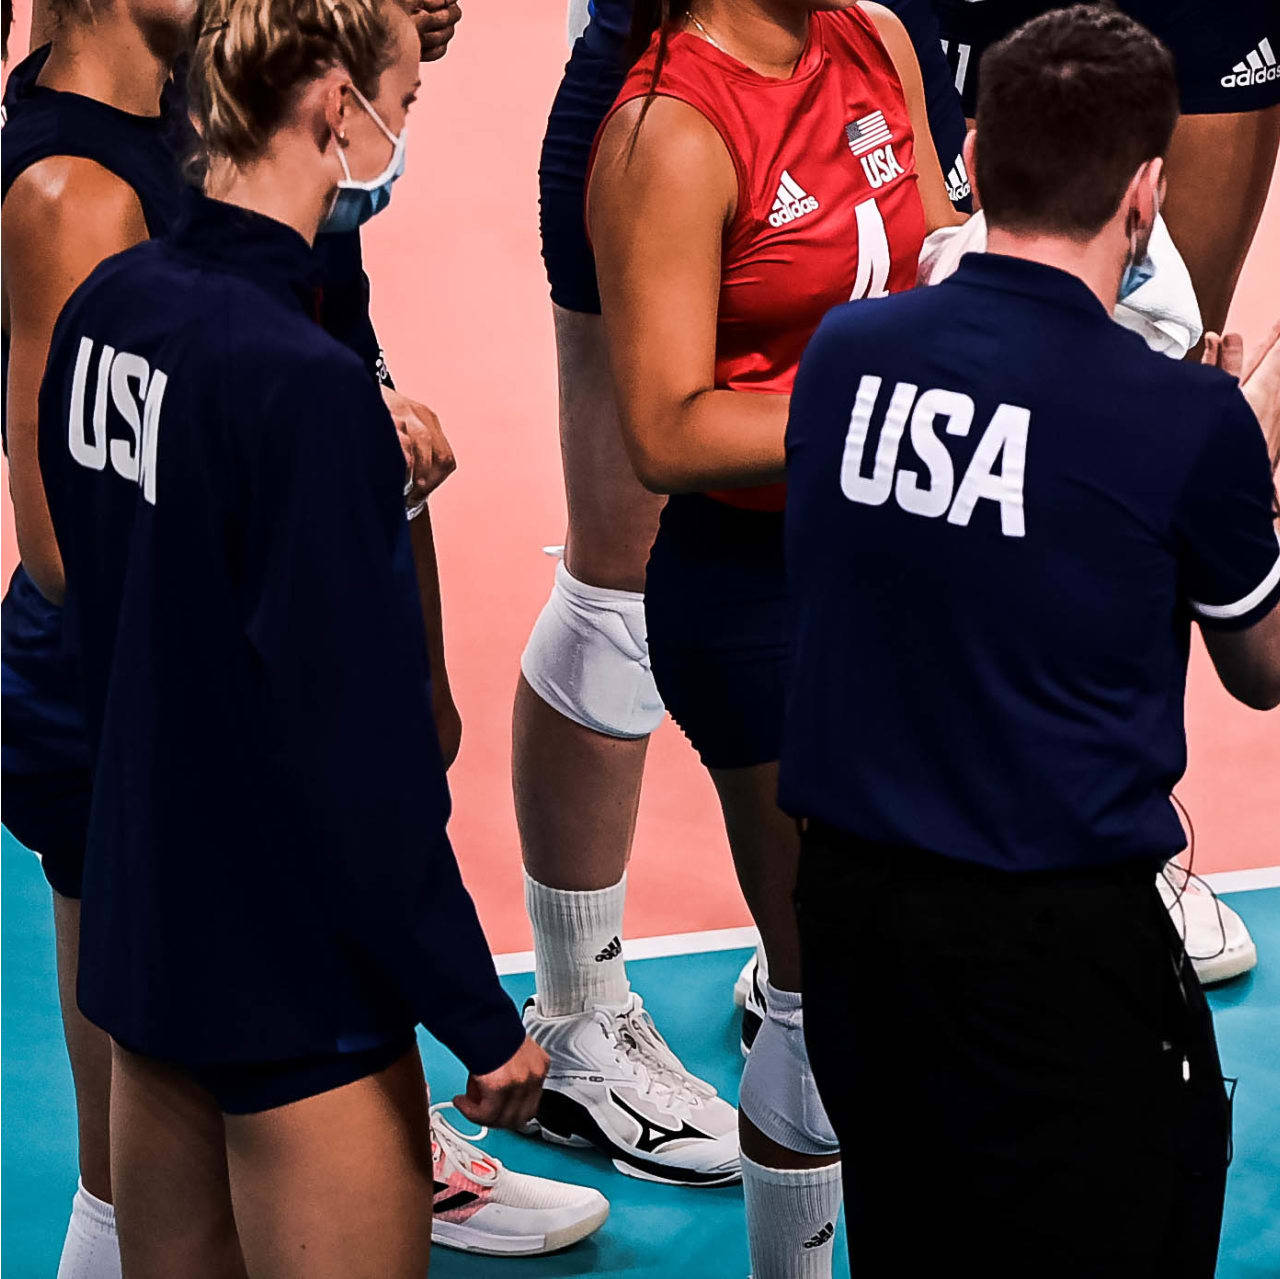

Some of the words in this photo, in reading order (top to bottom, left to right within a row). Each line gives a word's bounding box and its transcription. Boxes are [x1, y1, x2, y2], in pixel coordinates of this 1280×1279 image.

[860, 144, 905, 189] USA
[768, 195, 819, 227] adidas
[840, 375, 1031, 538] USA
